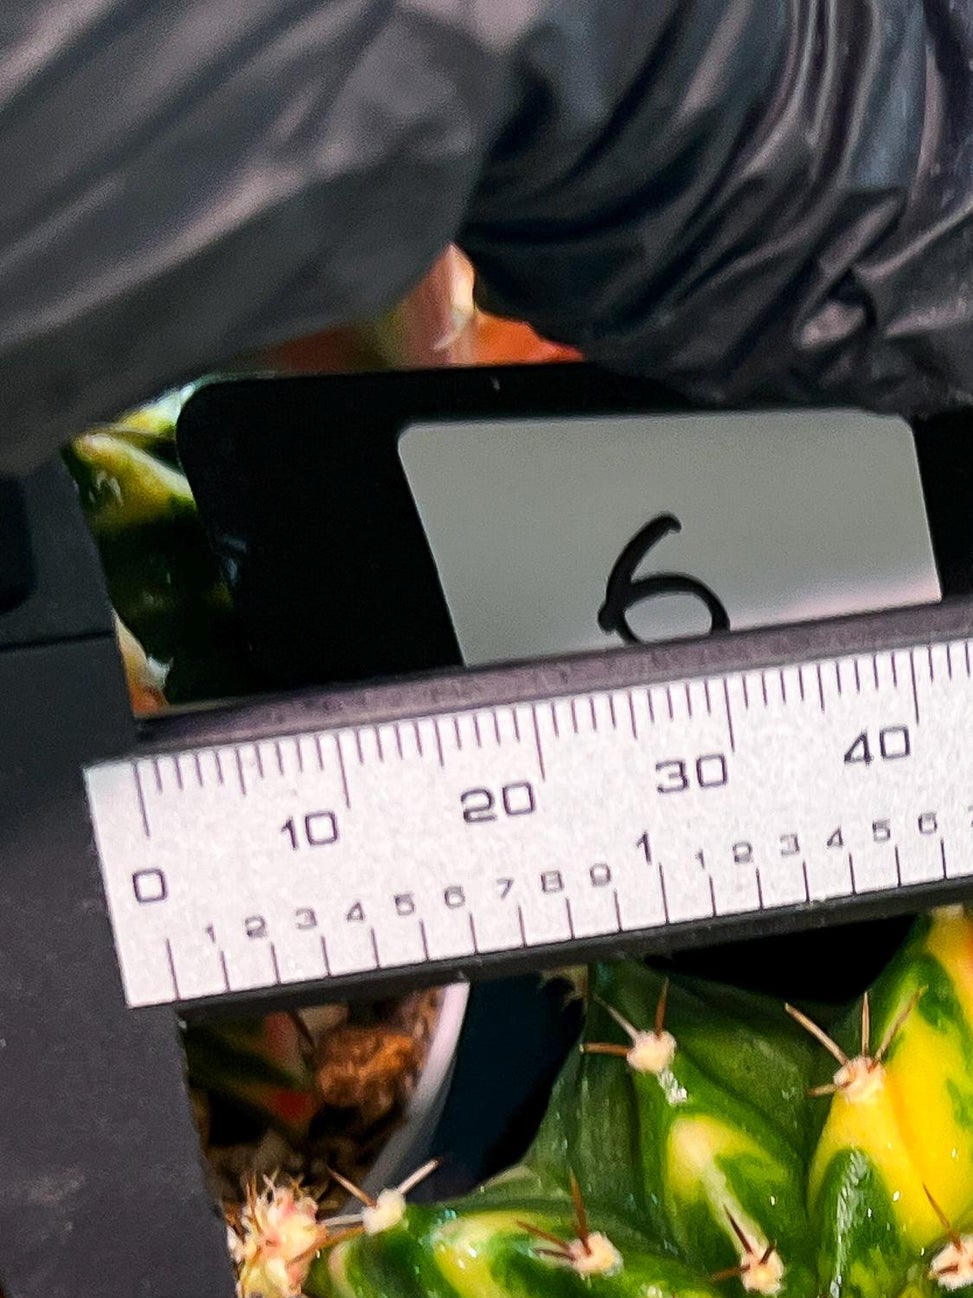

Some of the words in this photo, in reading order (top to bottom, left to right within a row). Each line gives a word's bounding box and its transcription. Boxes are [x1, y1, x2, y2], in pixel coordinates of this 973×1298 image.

[598, 511, 731, 645] 6
[132, 868, 168, 904] 0
[281, 810, 339, 850] 10
[460, 781, 536, 823] 20
[655, 753, 728, 794] 30
[844, 725, 911, 766] 40
[205, 921, 217, 943] 1
[245, 915, 267, 938] 2
[295, 907, 318, 931] 3
[347, 901, 365, 922] 4
[394, 894, 415, 916] 5
[444, 886, 466, 909] 6
[496, 878, 514, 900] 7
[540, 870, 564, 893] 8
[636, 831, 651, 866] 1
[696, 848, 705, 869] 1
[732, 841, 753, 864] 2
[780, 833, 800, 857] 3
[827, 826, 844, 848] 4
[872, 818, 891, 842] 5
[918, 811, 938, 835] 6
